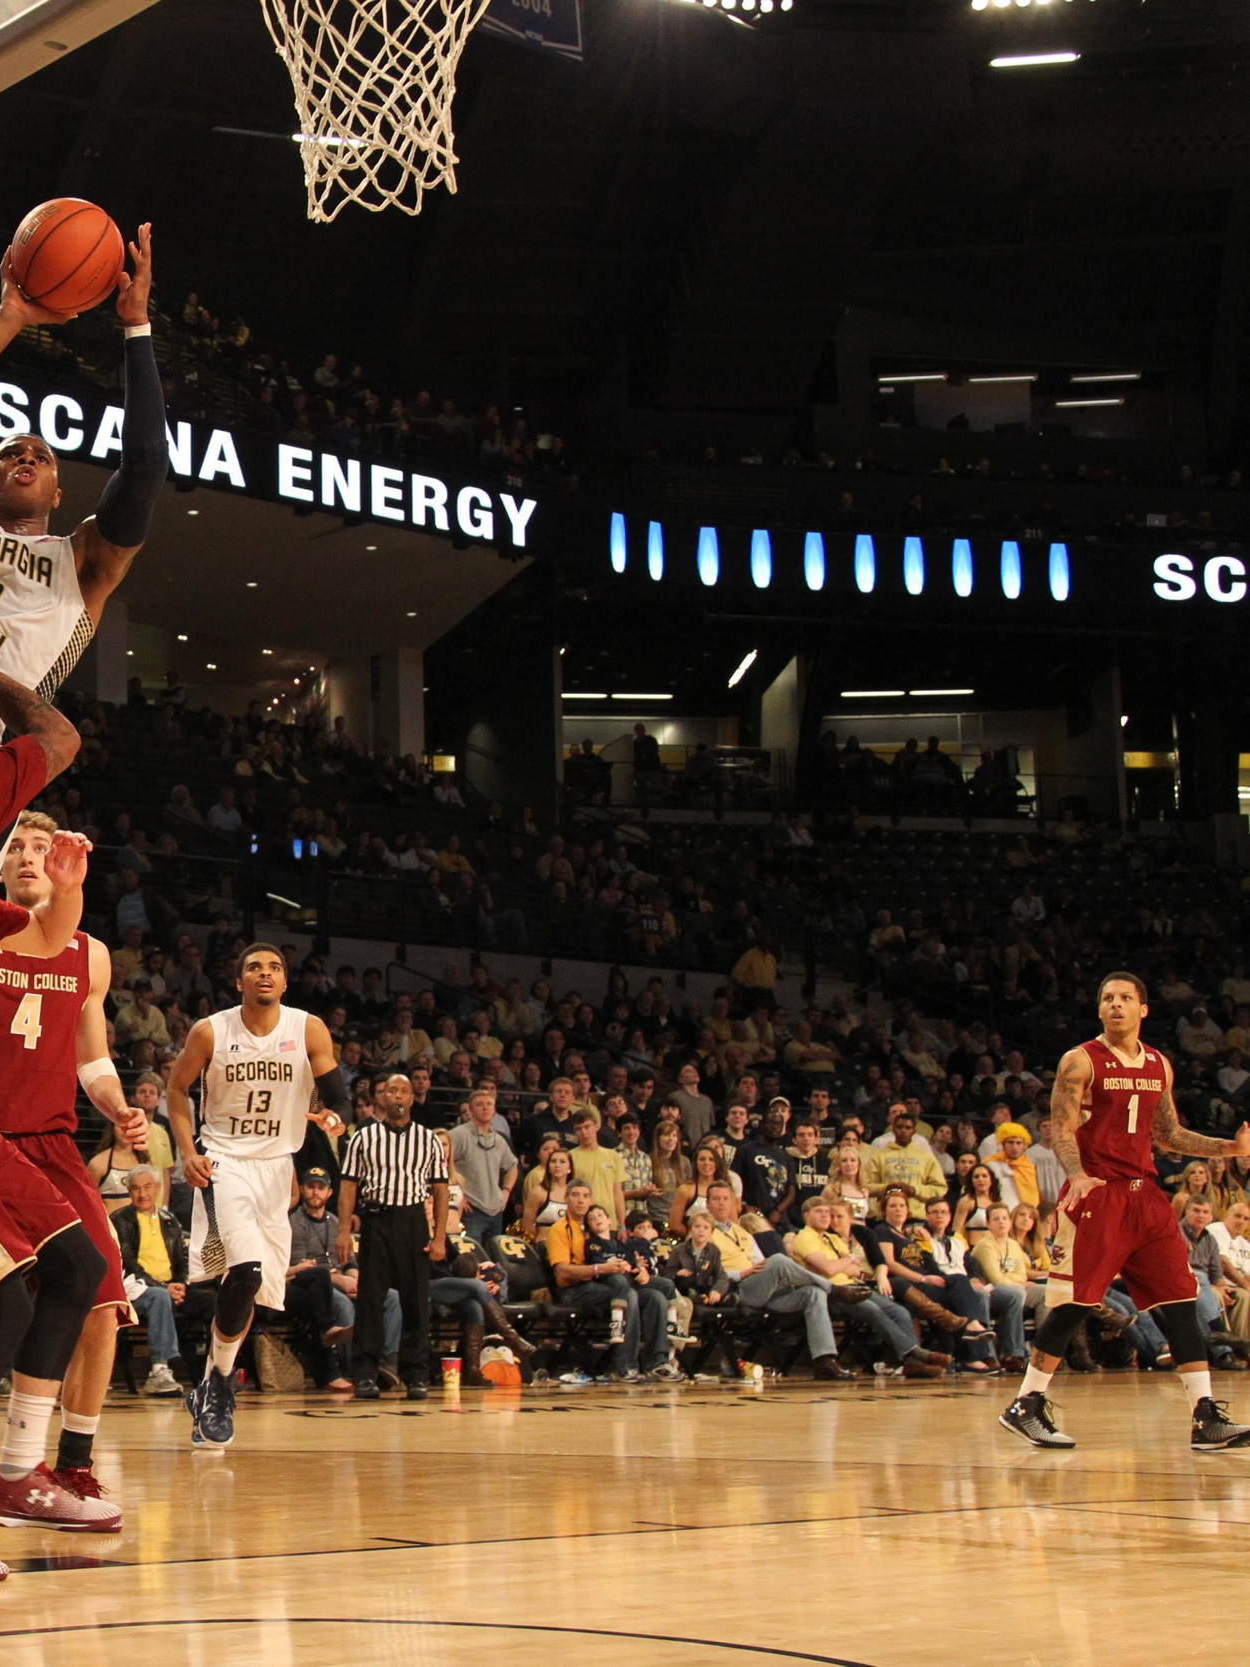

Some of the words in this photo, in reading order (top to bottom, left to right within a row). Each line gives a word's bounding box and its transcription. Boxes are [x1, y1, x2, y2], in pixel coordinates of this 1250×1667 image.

[279, 444, 536, 546] ENERGY
[32, 973, 78, 994] COLLEGE
[10, 991, 43, 1050] 4
[225, 1060, 293, 1082] GEORGIA
[1103, 1077, 1134, 1091] BOSTON
[1135, 1078, 1162, 1092] COLLEGE
[246, 1090, 272, 1113] 13
[1127, 1094, 1140, 1134] 1
[229, 1116, 281, 1137] TECH
